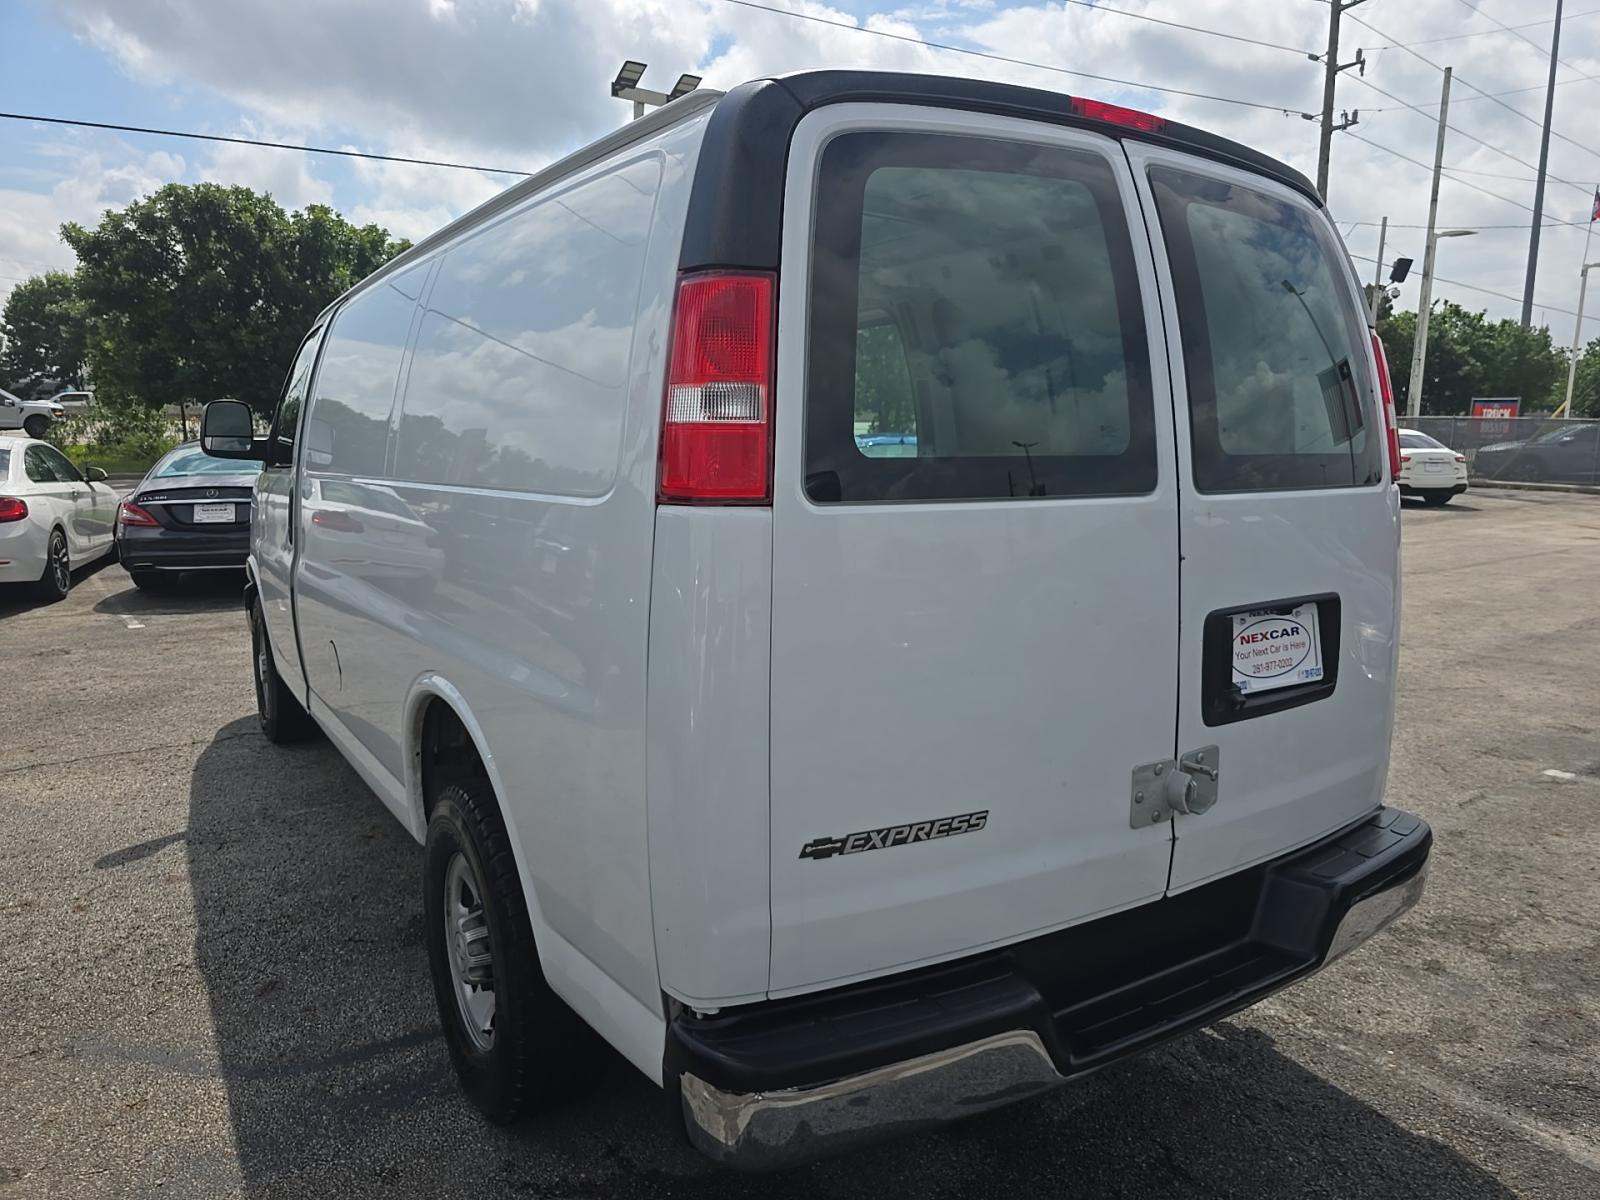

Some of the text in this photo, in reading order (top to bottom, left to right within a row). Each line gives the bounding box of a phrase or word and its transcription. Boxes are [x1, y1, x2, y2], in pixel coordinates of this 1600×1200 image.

[1240, 626, 1300, 645] NEXCAR
[1235, 640, 1306, 660] Your Next Car is Here
[843, 811, 989, 855] EXPRESS
